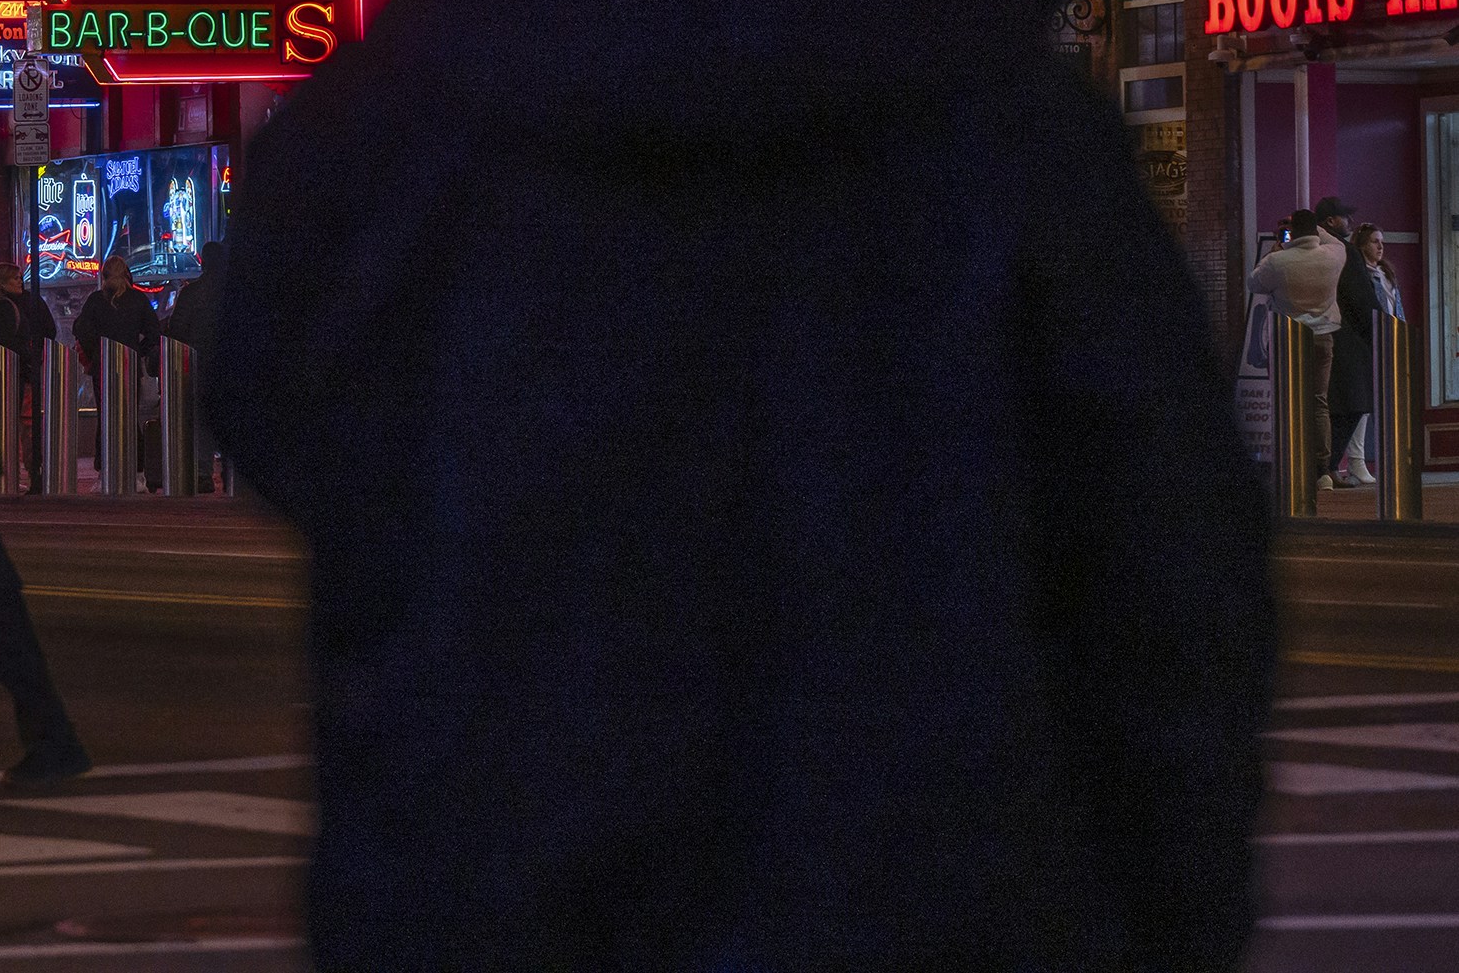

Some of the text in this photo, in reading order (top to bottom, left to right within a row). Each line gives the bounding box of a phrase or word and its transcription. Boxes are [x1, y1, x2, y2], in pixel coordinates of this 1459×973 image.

[49, 10, 272, 48] BAR-B-QUE
[18, 93, 44, 102] LOADING
[23, 102, 39, 111] ZONE
[38, 177, 63, 211] Lite
